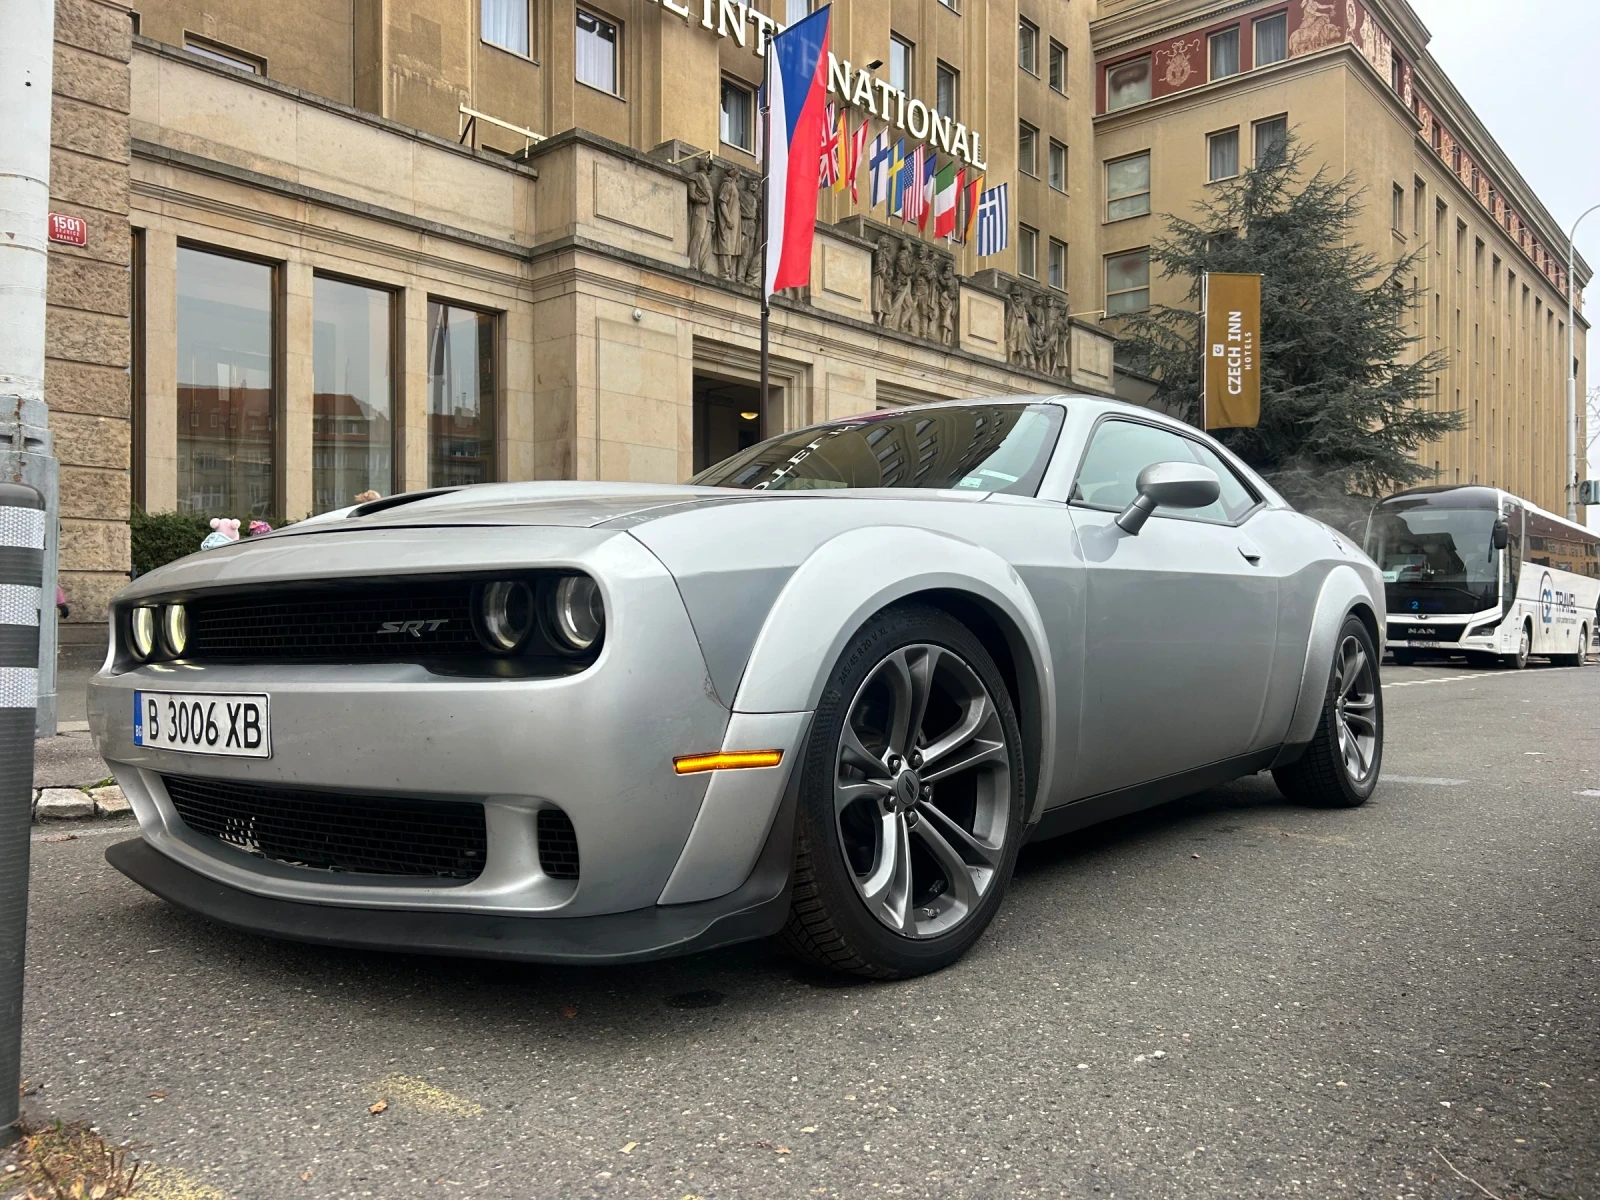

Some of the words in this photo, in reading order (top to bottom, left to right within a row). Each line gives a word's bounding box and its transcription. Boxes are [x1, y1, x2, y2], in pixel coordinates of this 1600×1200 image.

[53, 216, 80, 232] 1501
[1228, 311, 1242, 342] INN
[1228, 347, 1242, 395] CZECH
[376, 619, 450, 638] SRT
[1407, 627, 1436, 635] MAN
[135, 725, 143, 737] BG
[148, 699, 159, 740] B
[168, 700, 219, 746] 3006
[225, 702, 262, 749] XB
